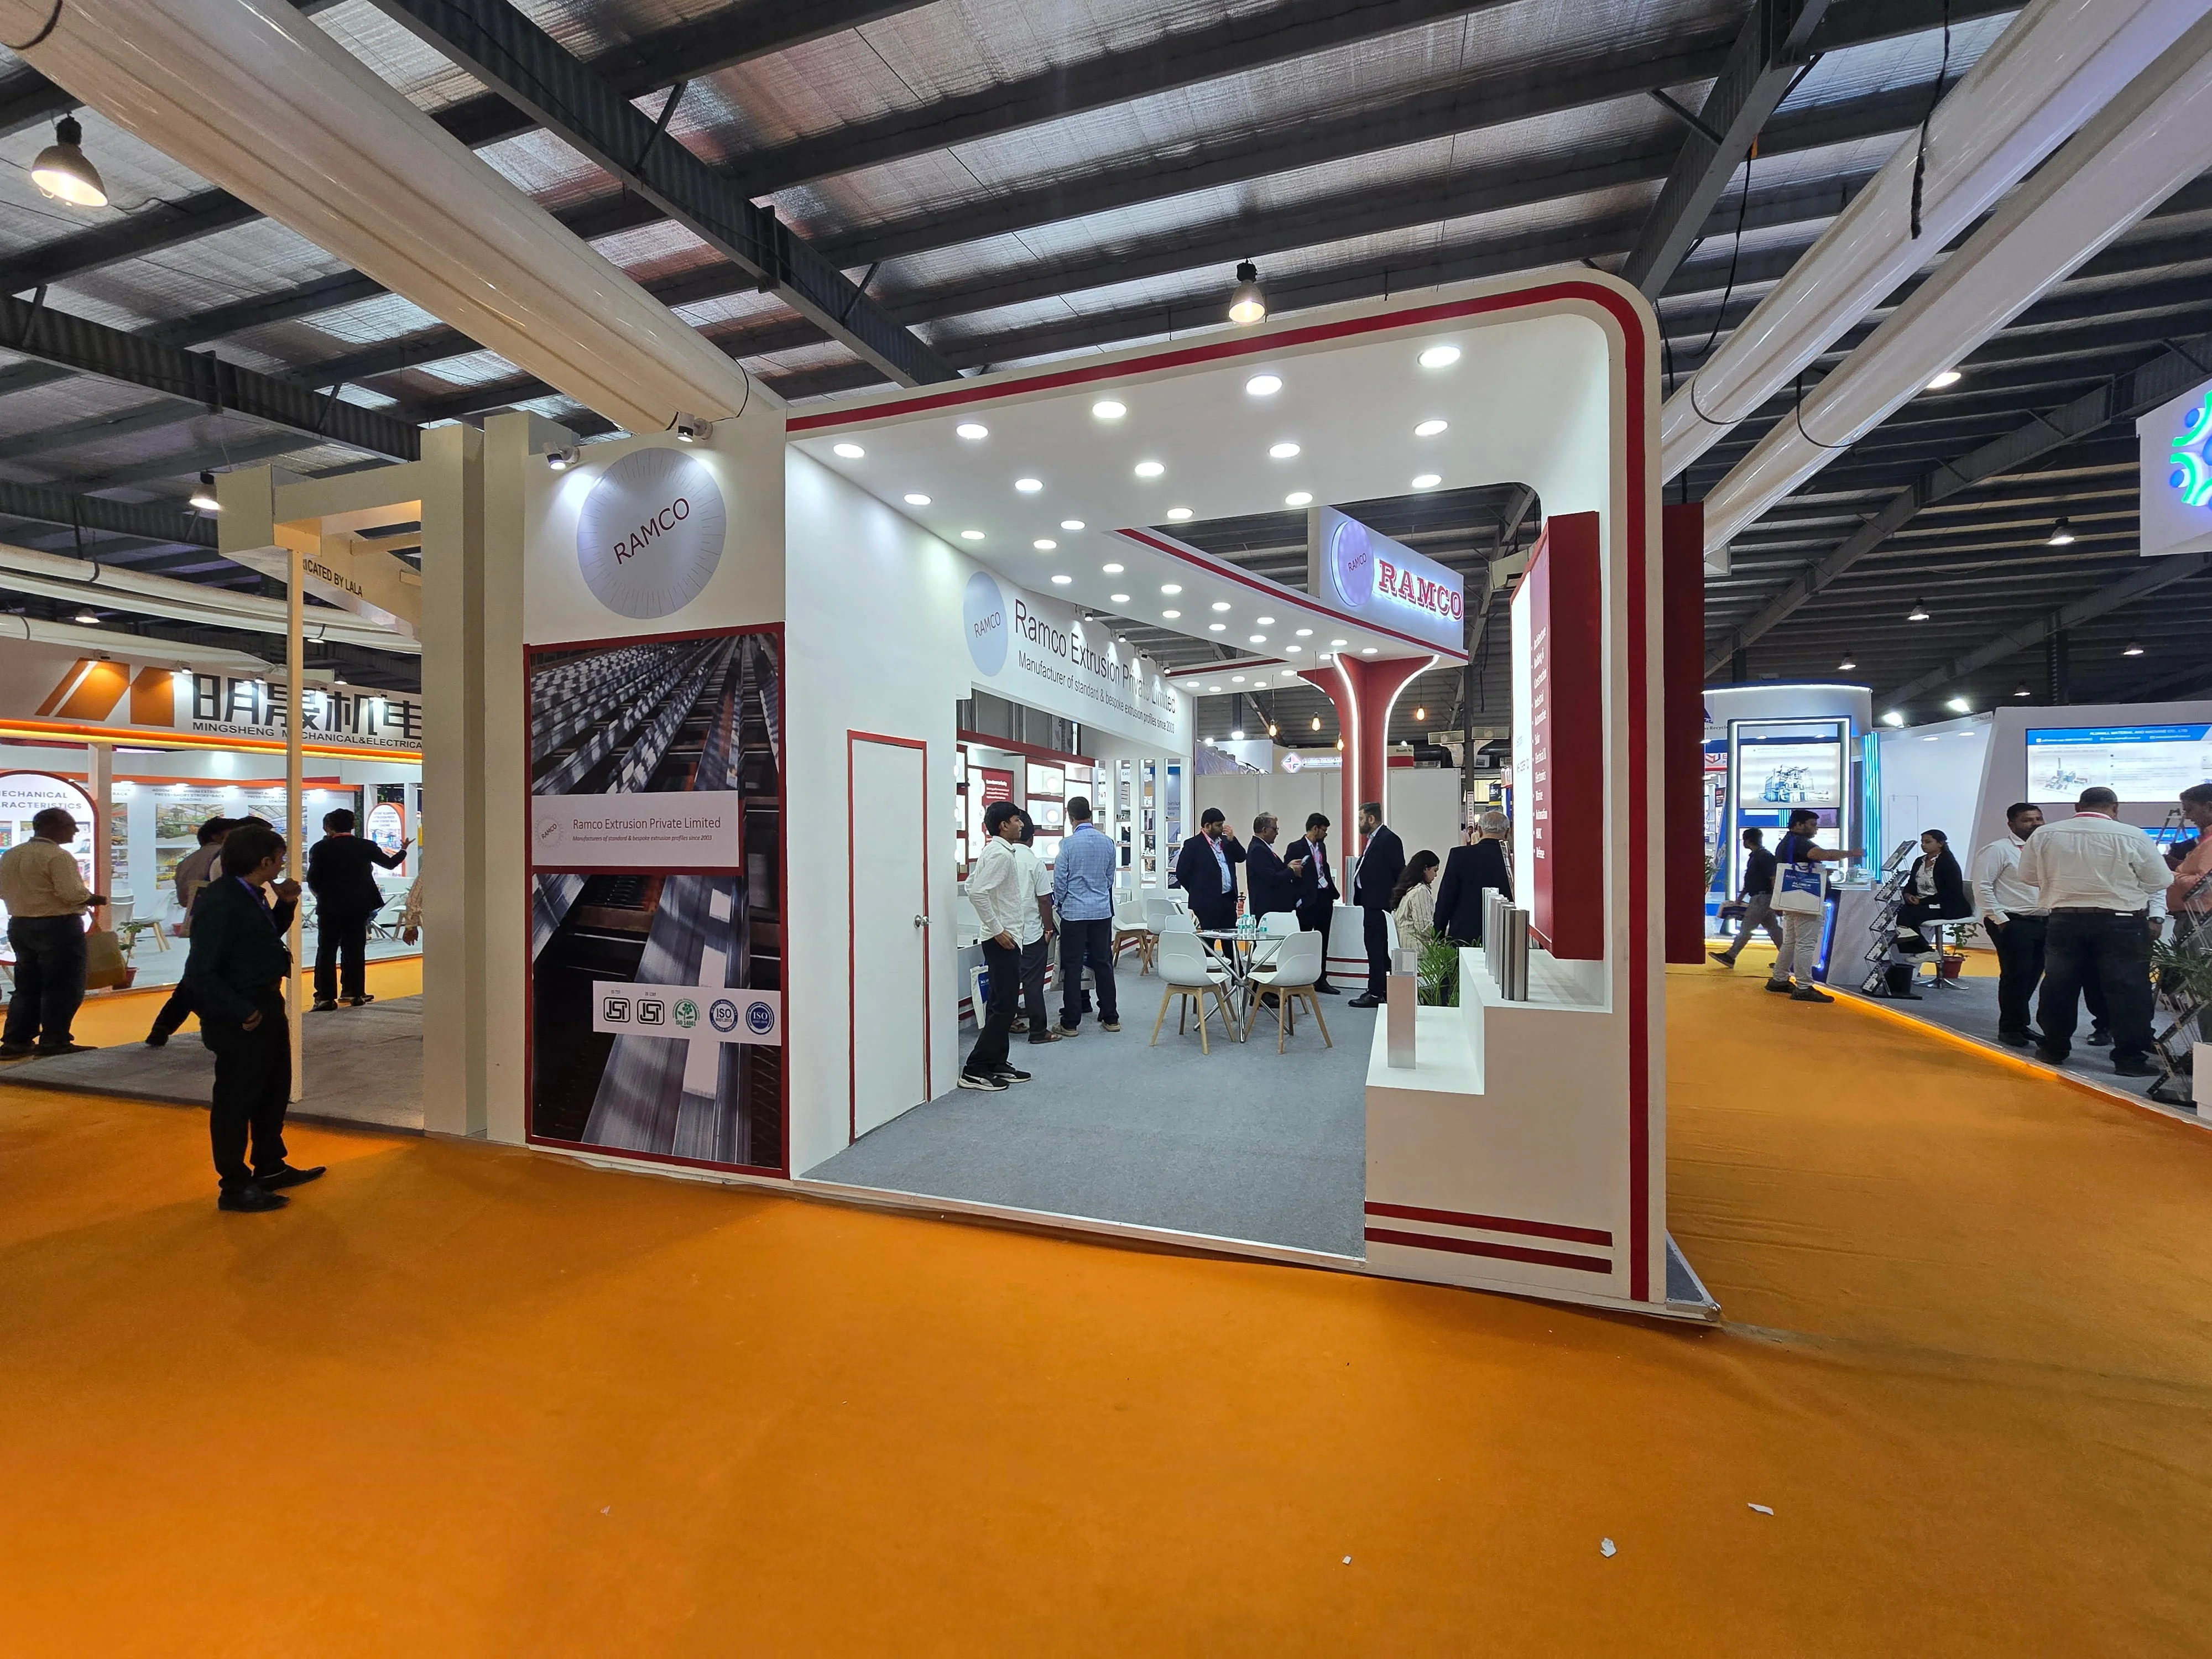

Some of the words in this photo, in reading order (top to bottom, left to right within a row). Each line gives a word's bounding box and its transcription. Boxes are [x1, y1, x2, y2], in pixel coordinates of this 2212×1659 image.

[613, 498, 690, 565] RAMCO
[1348, 553, 1367, 572] RAMCO
[334, 572, 343, 587] BY
[345, 578, 363, 598] LALA
[1379, 559, 1463, 620] RAMCO
[974, 612, 1001, 638] RAMCO
[1015, 599, 1067, 658] Ramco
[1071, 633, 1120, 686] Extrusion
[1123, 664, 1150, 701] Private
[1152, 680, 1176, 713] Limited
[1019, 650, 1066, 686] Manufacturer
[1067, 675, 1073, 690] of
[1074, 680, 1099, 701] standard
[1100, 688, 1104, 702] &
[1105, 693, 1124, 712] bespoke
[1124, 704, 1143, 720] extrusion
[1143, 713, 1156, 726] profiles
[1157, 717, 1166, 730] since
[1166, 721, 1175, 734] 2003
[192, 722, 274, 737] MINGSHENG
[541, 823, 557, 840] RAMCO
[573, 818, 603, 830] Ramco
[605, 818, 648, 830] Extrusion
[650, 818, 682, 829] Private
[685, 816, 721, 828] Limited
[716, 1008, 732, 1019] ISO
[753, 1011, 768, 1020] ISO
